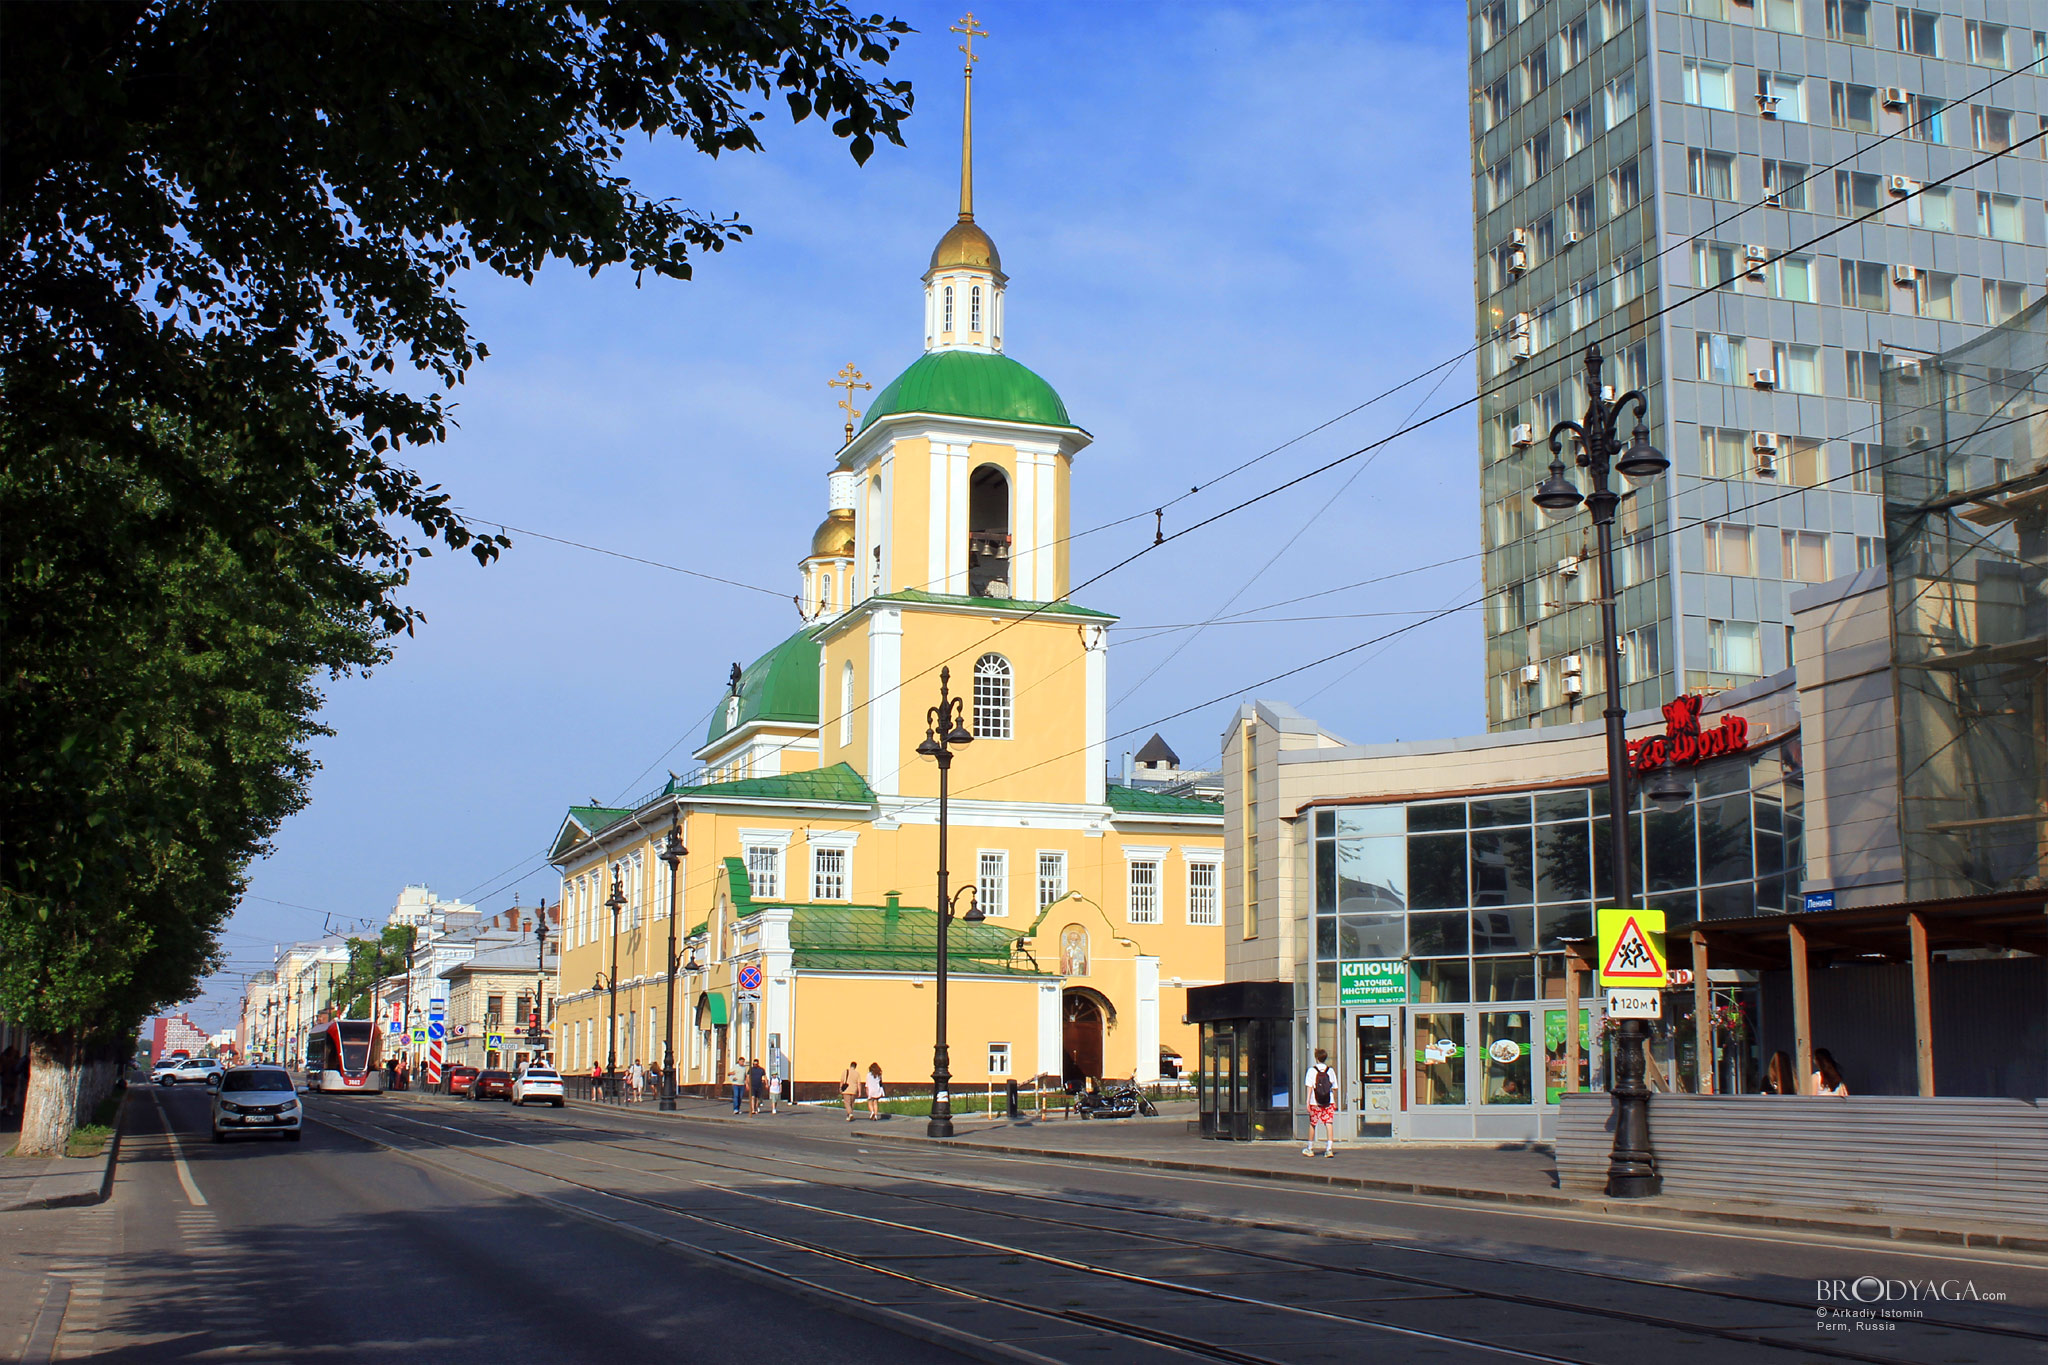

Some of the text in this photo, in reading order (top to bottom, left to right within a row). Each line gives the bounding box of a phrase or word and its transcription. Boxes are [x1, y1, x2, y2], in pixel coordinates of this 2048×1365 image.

[1807, 899, 1833, 909] Ленина
[1341, 962, 1405, 977] КЛЮЧИ
[1353, 979, 1393, 988] ЗАТОЧКА
[1341, 986, 1406, 995] ИНСТРУМЕНТА
